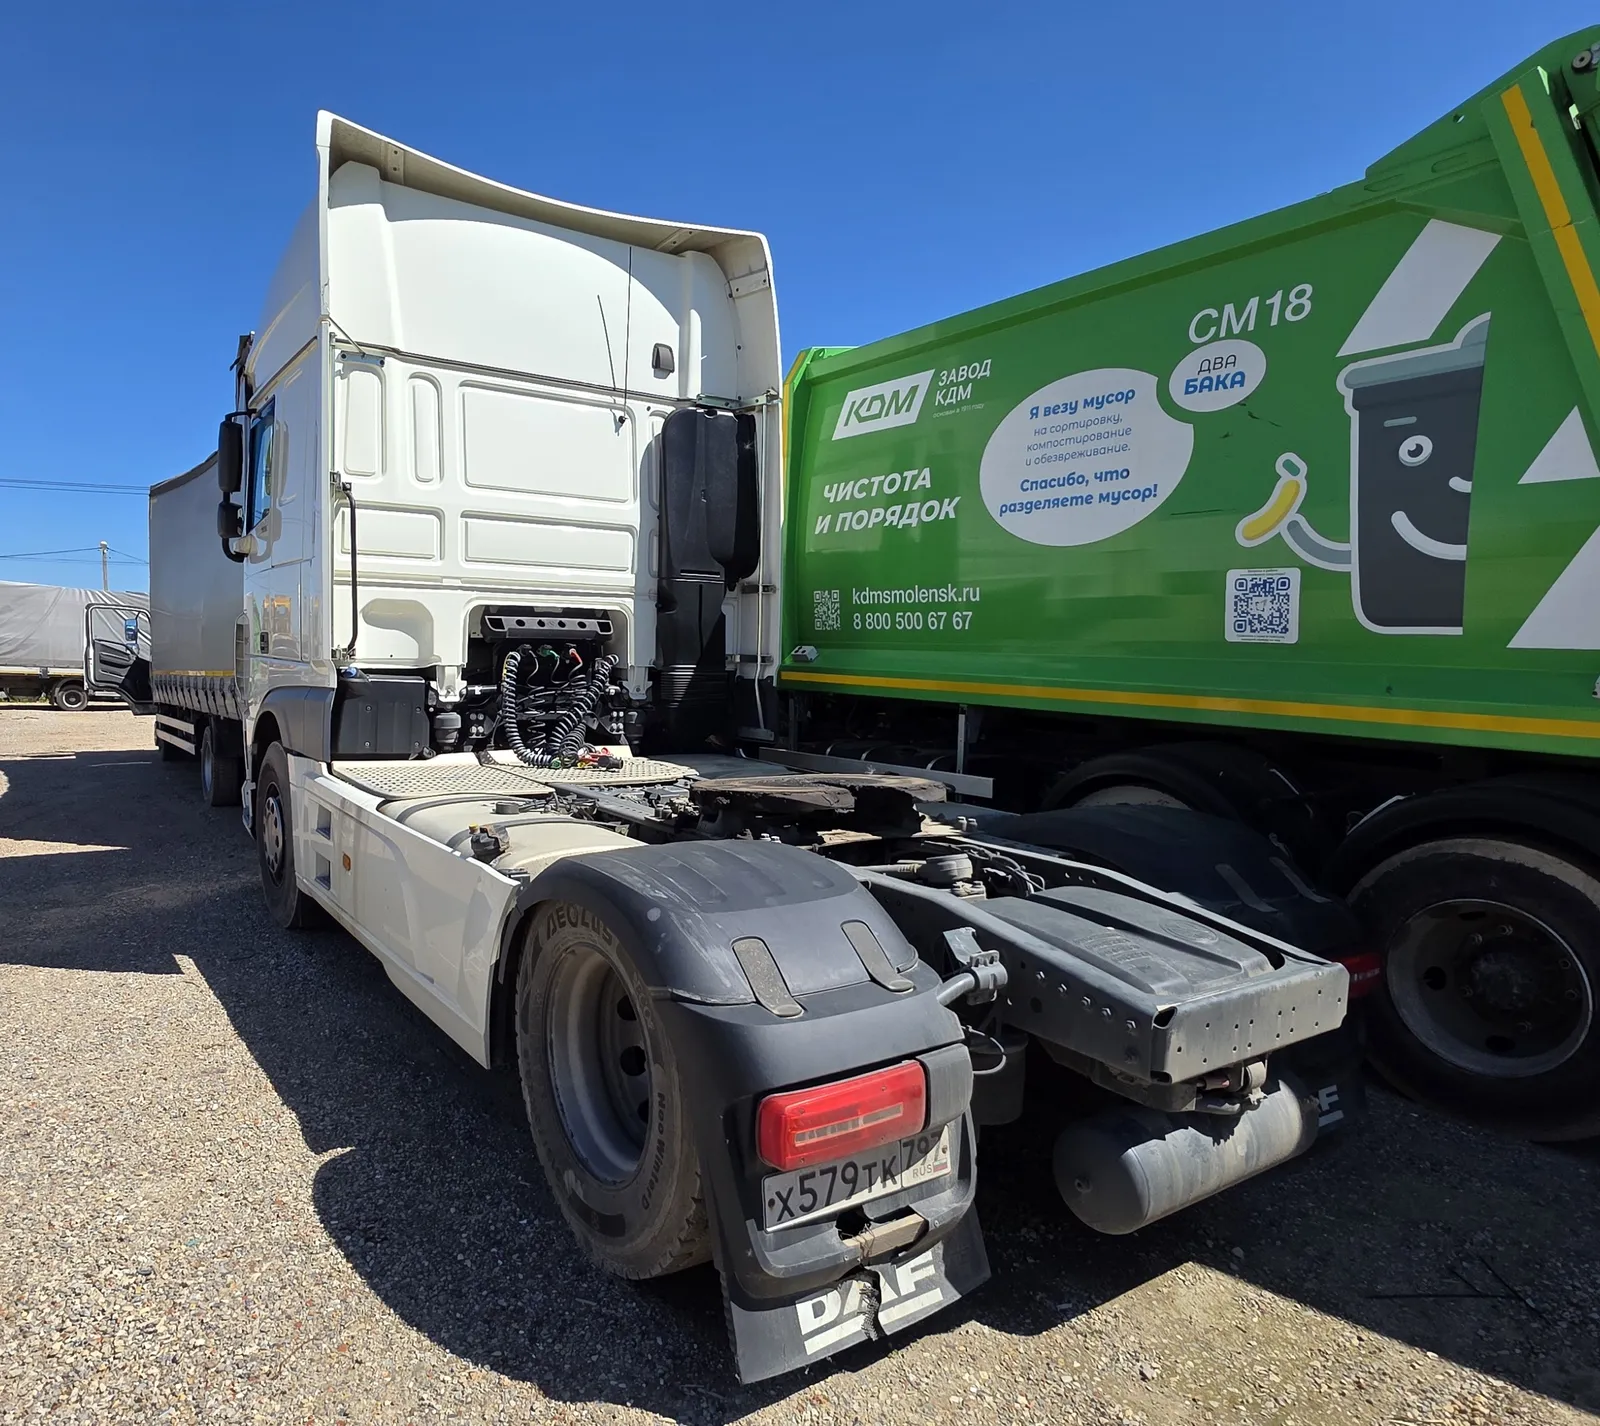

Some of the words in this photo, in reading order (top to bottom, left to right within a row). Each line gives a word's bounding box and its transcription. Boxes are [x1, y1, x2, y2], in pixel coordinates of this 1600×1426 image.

[938, 359, 992, 387] ЗАВОД
[1197, 354, 1237, 375] ДВА
[935, 383, 972, 406] КДМ
[1183, 370, 1246, 396] БАКА
[843, 384, 920, 428] KDM
[1029, 405, 1040, 420] Я
[1043, 400, 1079, 417] везу
[1082, 388, 1136, 409] мусор
[1034, 427, 1047, 437] на
[1049, 413, 1123, 434] сортировку,
[1026, 427, 1132, 452] компостирование
[1025, 458, 1032, 466] и
[1034, 443, 1131, 466] обезвреживание.
[823, 467, 932, 503] ЧИСТОТА
[1020, 472, 1089, 493] Спасибо,
[1094, 468, 1130, 483] что
[999, 493, 1094, 517] разделяете
[1098, 483, 1158, 506] мусор!
[814, 515, 832, 535] И
[835, 496, 962, 533] ПОРЯДОК
[852, 584, 980, 605] kdmsmolensk.ru
[853, 613, 862, 630] 8
[865, 612, 891, 630] 800
[895, 612, 925, 630] 500
[929, 611, 947, 630] 67
[952, 611, 973, 630] 67
[912, 1163, 932, 1179] RUS
